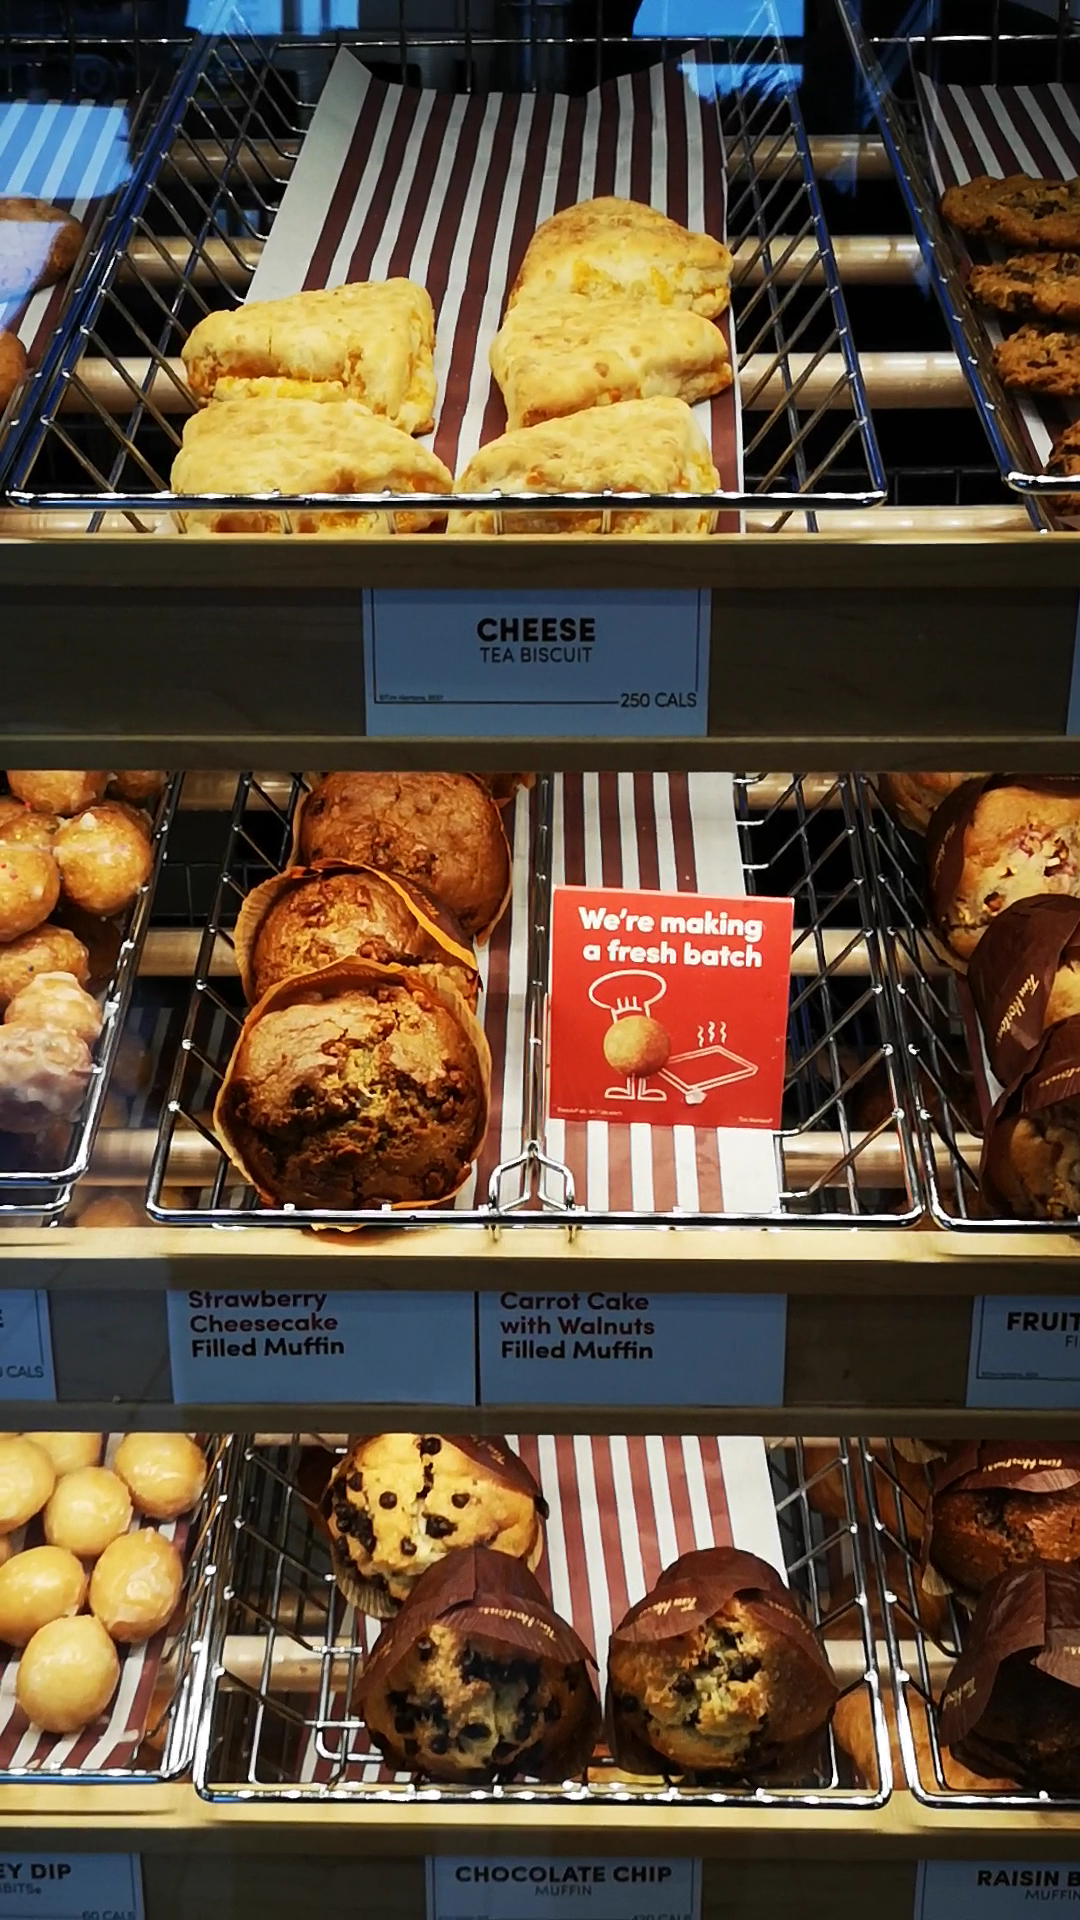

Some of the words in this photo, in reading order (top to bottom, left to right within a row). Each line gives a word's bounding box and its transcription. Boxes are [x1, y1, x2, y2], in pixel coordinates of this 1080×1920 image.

[477, 618, 595, 642] CHEESE
[480, 648, 515, 663] TEA
[521, 648, 593, 663] BISCUIT
[620, 692, 650, 708] 250
[654, 692, 697, 708] CALS
[578, 906, 655, 933] We're
[660, 910, 763, 943] making
[582, 944, 601, 962] a
[607, 939, 677, 965] fresh
[683, 942, 763, 968] batch
[188, 1289, 328, 1312] Strawberry
[500, 1291, 580, 1310] Carrot
[586, 1291, 650, 1311] Cake
[189, 1313, 338, 1333] Cheesecake
[499, 1315, 552, 1335] with
[557, 1316, 656, 1336] Walnuts
[1007, 1311, 1080, 1332] FRUIT
[191, 1338, 257, 1357] Filled
[264, 1336, 345, 1356] Muffin
[501, 1341, 566, 1359] Filled
[572, 1341, 654, 1360] Muffin
[6, 1365, 44, 1378] CALS
[30, 1863, 72, 1880] DIP
[455, 1866, 606, 1883] CHOCOLATE
[612, 1866, 673, 1883] CHIP
[977, 1870, 1060, 1887] RAISIN
[534, 1885, 592, 1897] MUFFIN
[1025, 1889, 1080, 1901] MUFFIN
